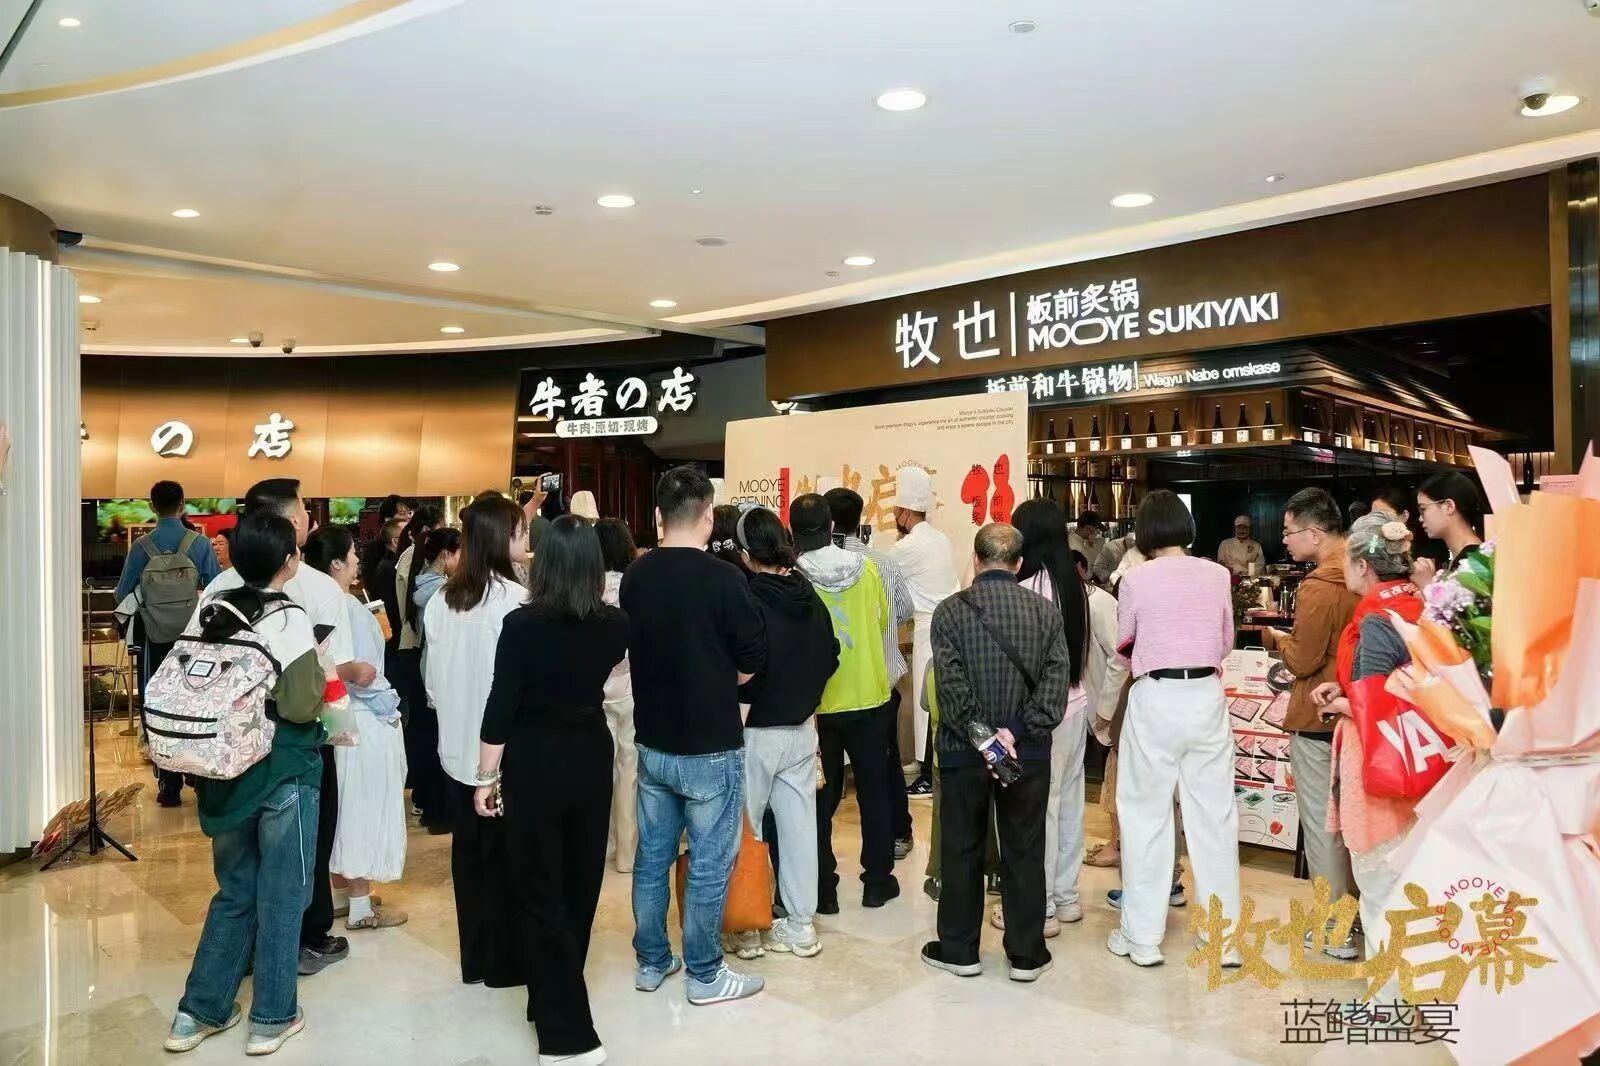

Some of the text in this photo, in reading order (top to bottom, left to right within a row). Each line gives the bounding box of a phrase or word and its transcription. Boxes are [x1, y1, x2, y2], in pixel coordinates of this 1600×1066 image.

[895, 300, 1000, 369] 牧也
[1028, 293, 1279, 352] MOOYE SUKIYAKI
[529, 366, 697, 420] 牛者の店
[1145, 373, 1183, 389] Wagyu
[1185, 369, 1220, 384] Nabe
[739, 478, 786, 493] MOOYE
